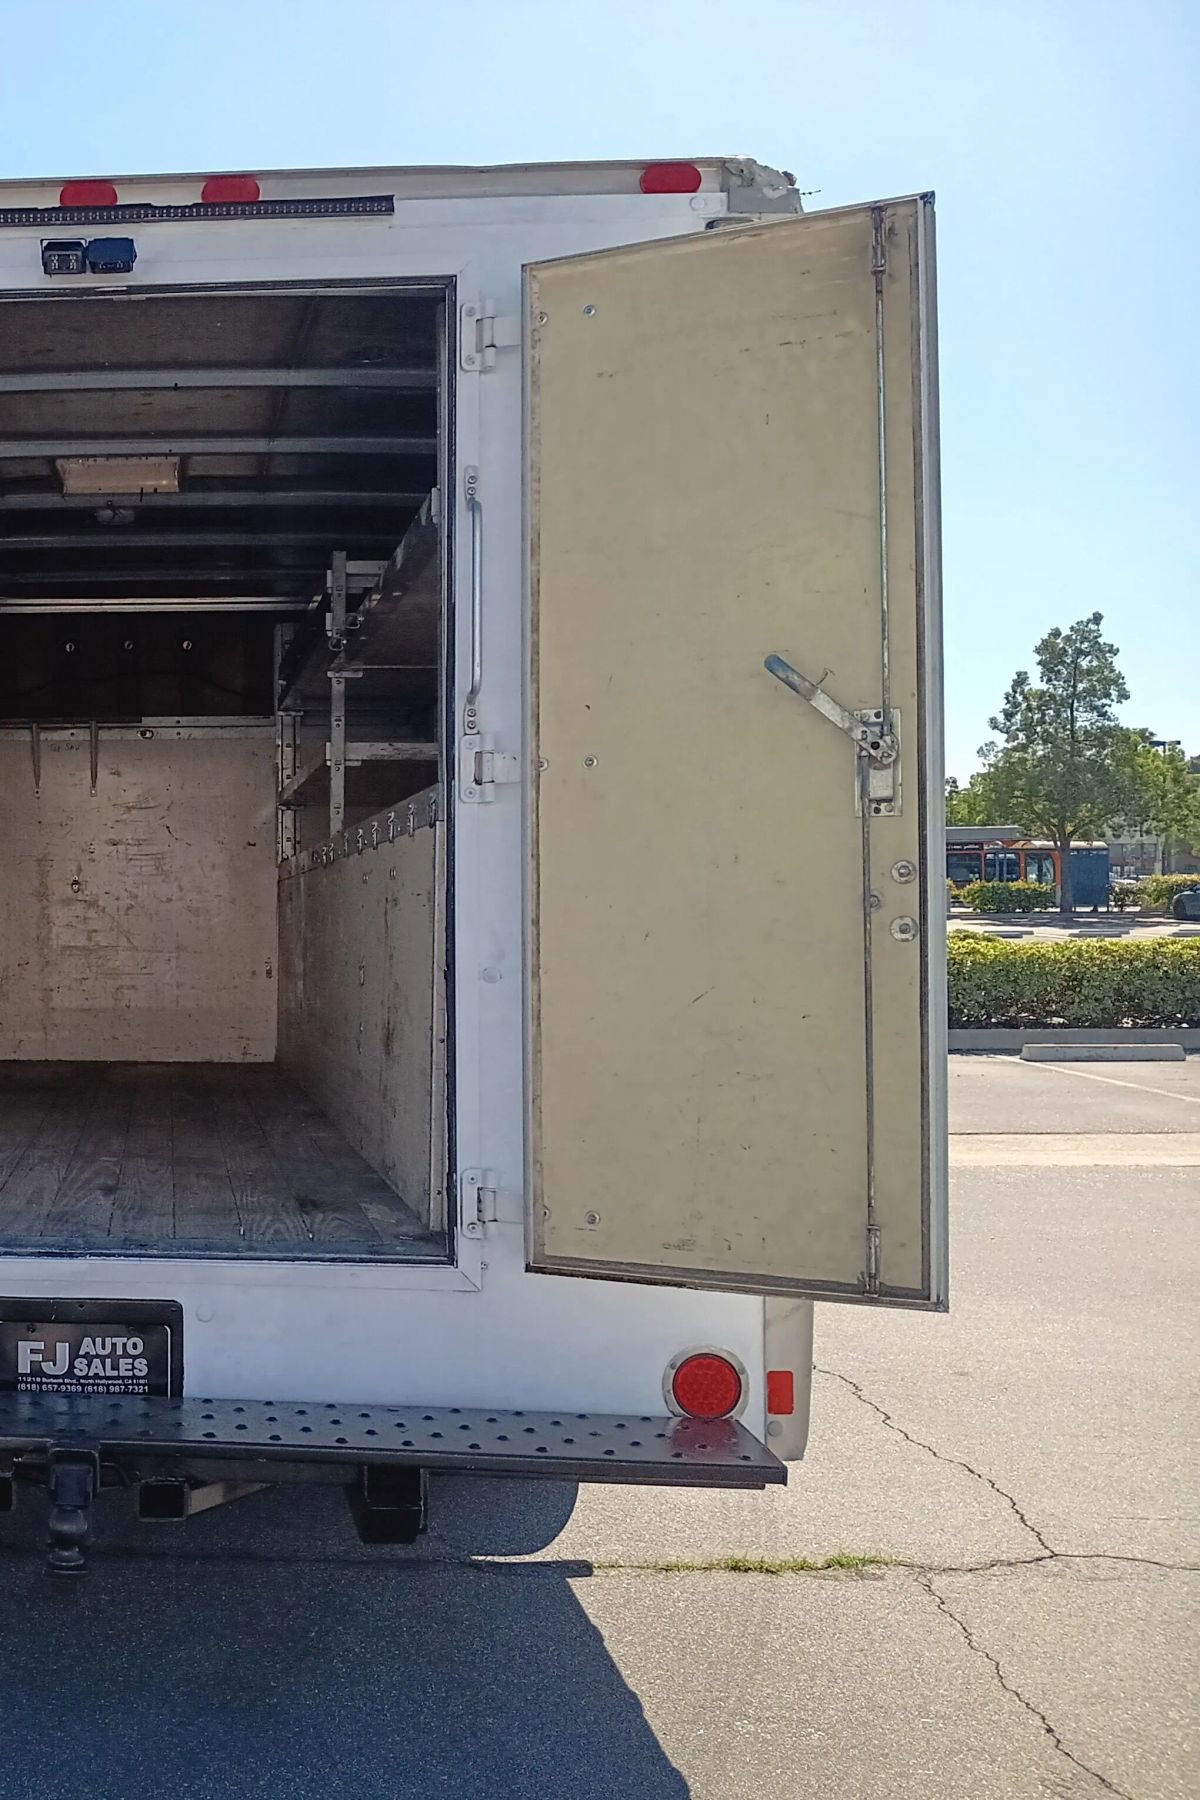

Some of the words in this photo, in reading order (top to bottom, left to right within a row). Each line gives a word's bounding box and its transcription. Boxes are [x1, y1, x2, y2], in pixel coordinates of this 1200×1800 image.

[79, 1337, 143, 1355] AUTO
[18, 1341, 69, 1375] FJ
[74, 1358, 148, 1376] SALES
[18, 1383, 40, 1392] (818)
[42, 1384, 82, 1393] 657-9369
[84, 1385, 107, 1394] (818)
[109, 1385, 149, 1393] 987-7321
